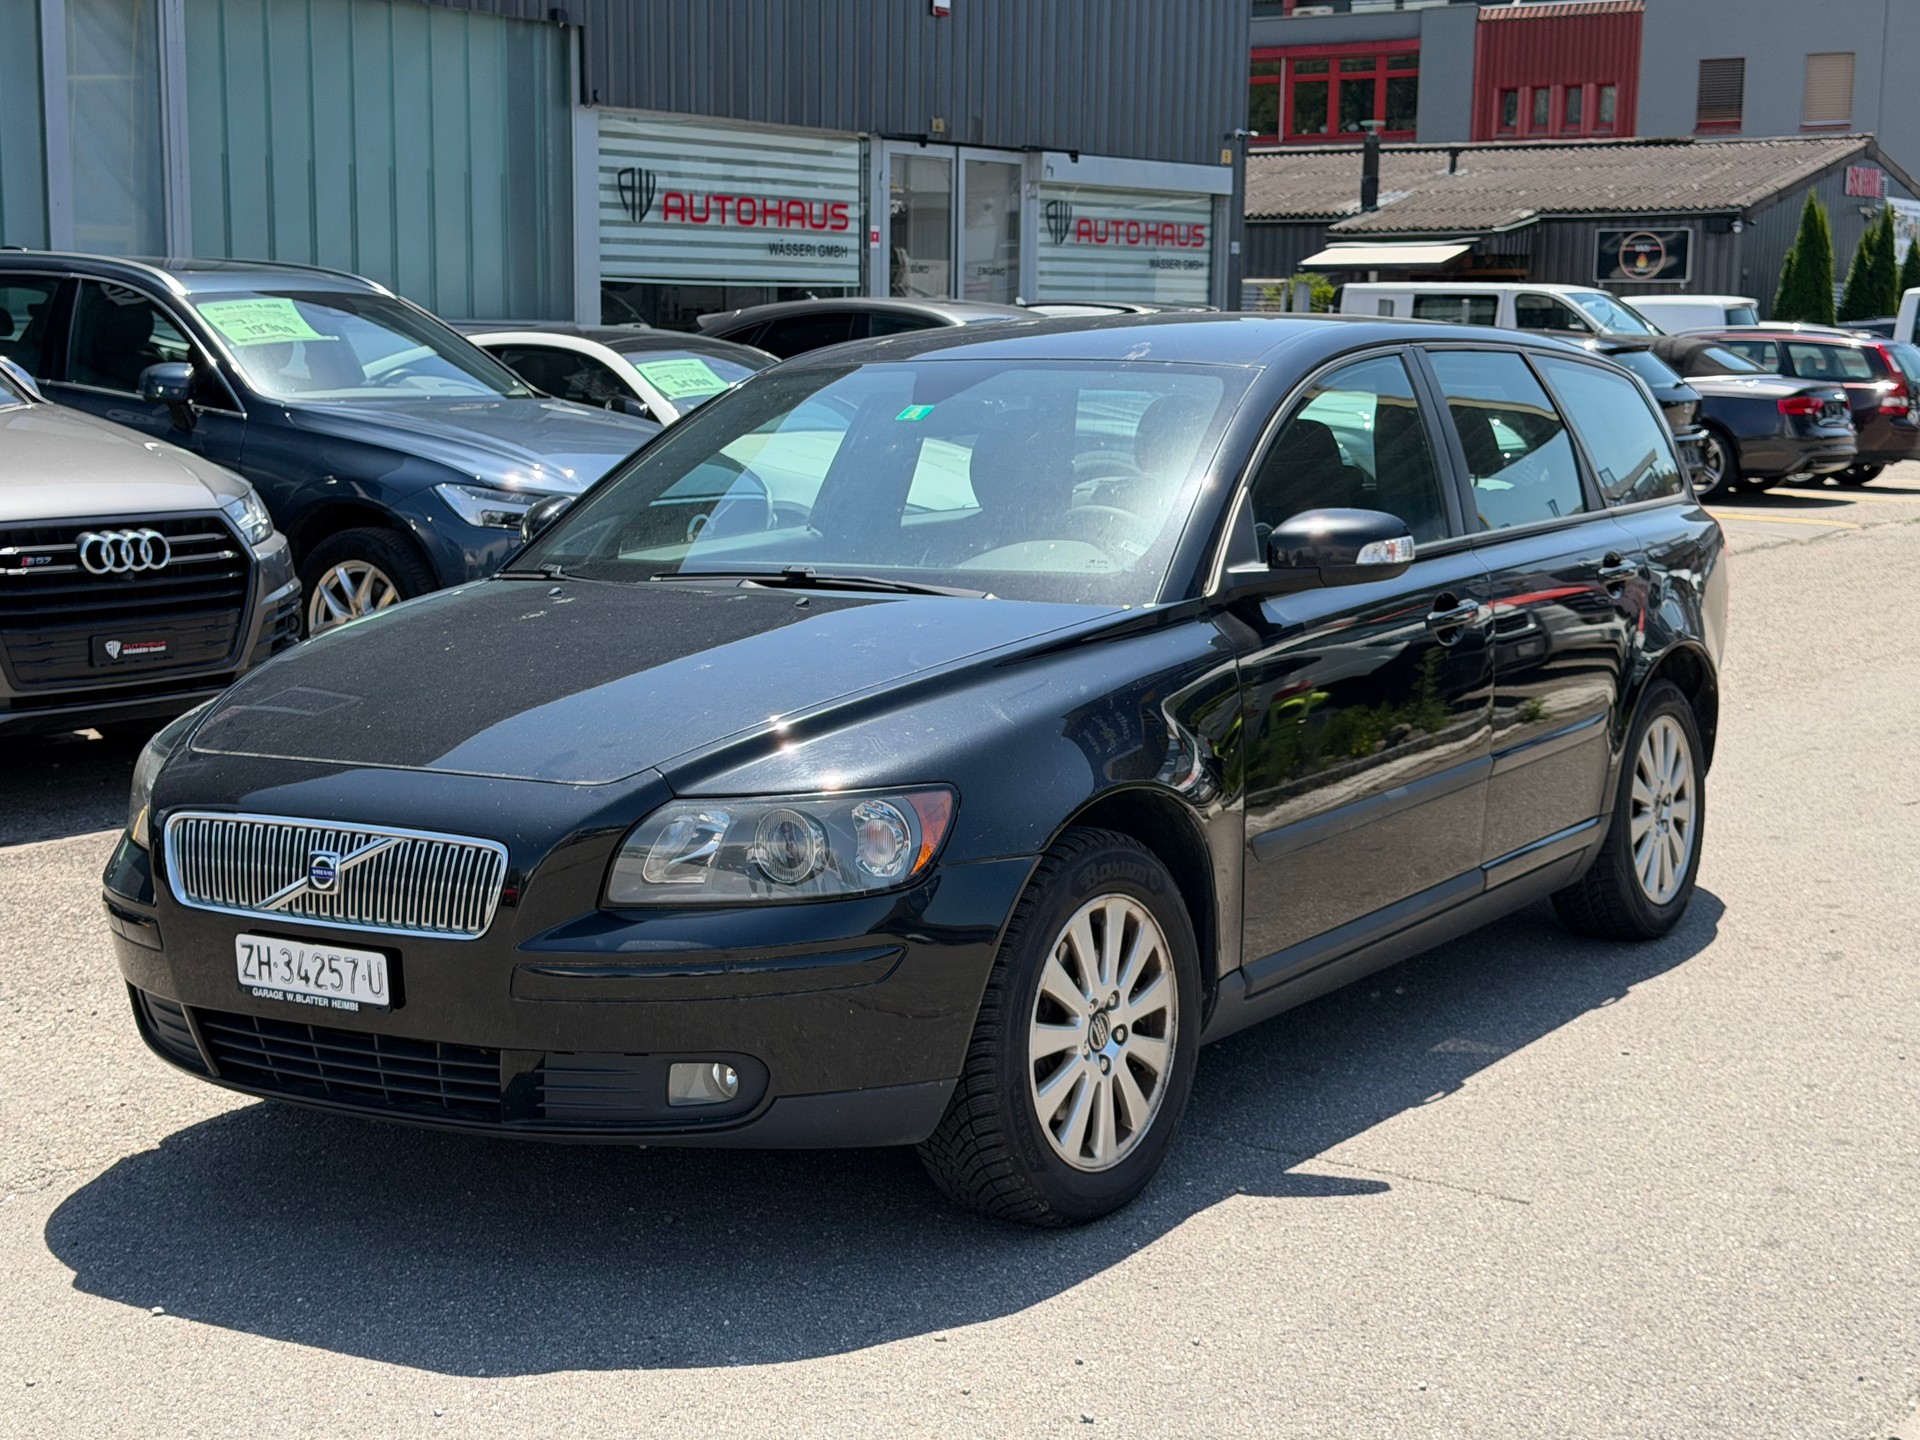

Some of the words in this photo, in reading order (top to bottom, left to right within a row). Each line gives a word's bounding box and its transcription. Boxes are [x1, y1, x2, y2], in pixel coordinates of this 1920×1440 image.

[663, 192, 849, 231] AUTOHAUS
[1076, 218, 1206, 248] AUTOHAUS
[768, 239, 816, 257] WÄSSERI
[818, 245, 848, 258] GMBH
[252, 987, 285, 1001] GARAGE
